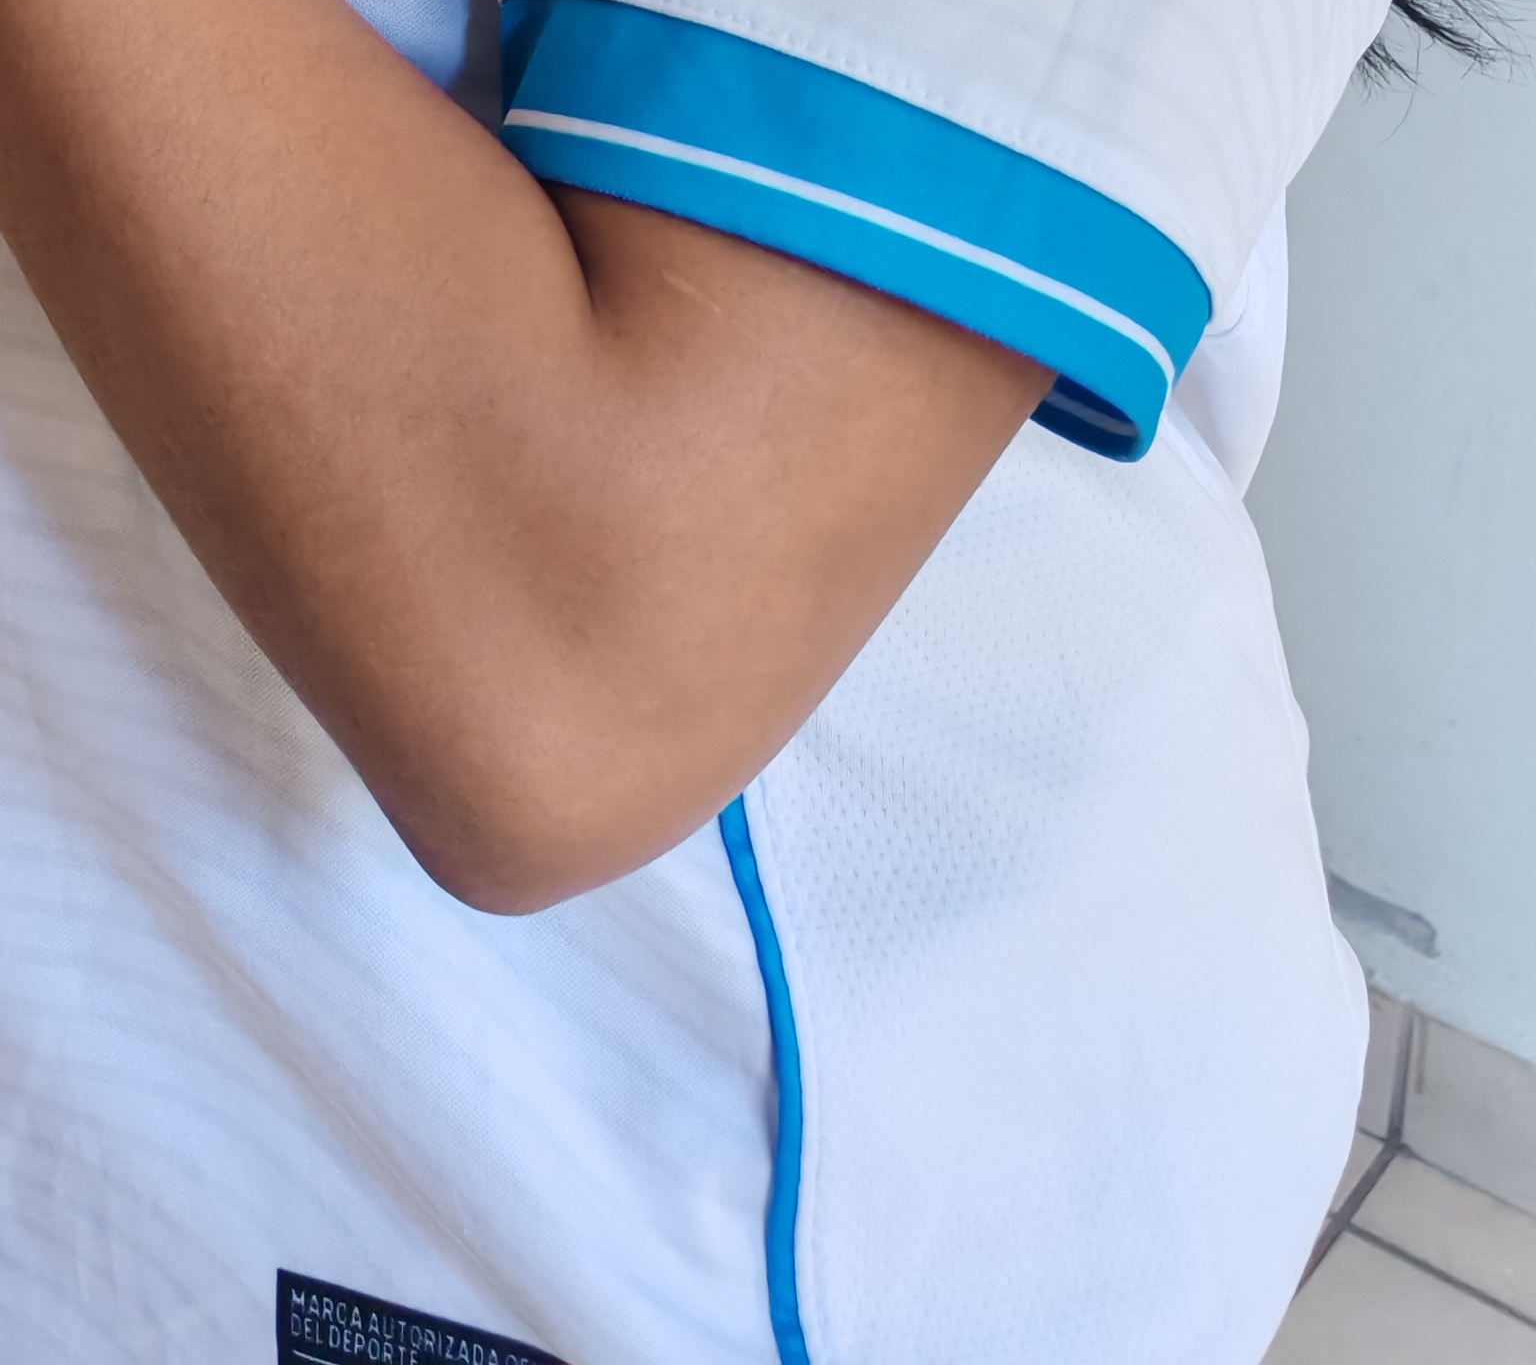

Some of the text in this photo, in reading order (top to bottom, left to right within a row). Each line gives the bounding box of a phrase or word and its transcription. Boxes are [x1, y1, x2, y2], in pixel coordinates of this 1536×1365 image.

[290, 1287, 499, 1365] MARCA AUTORIZADA
[290, 1312, 419, 1365] DEL DEPORTE
